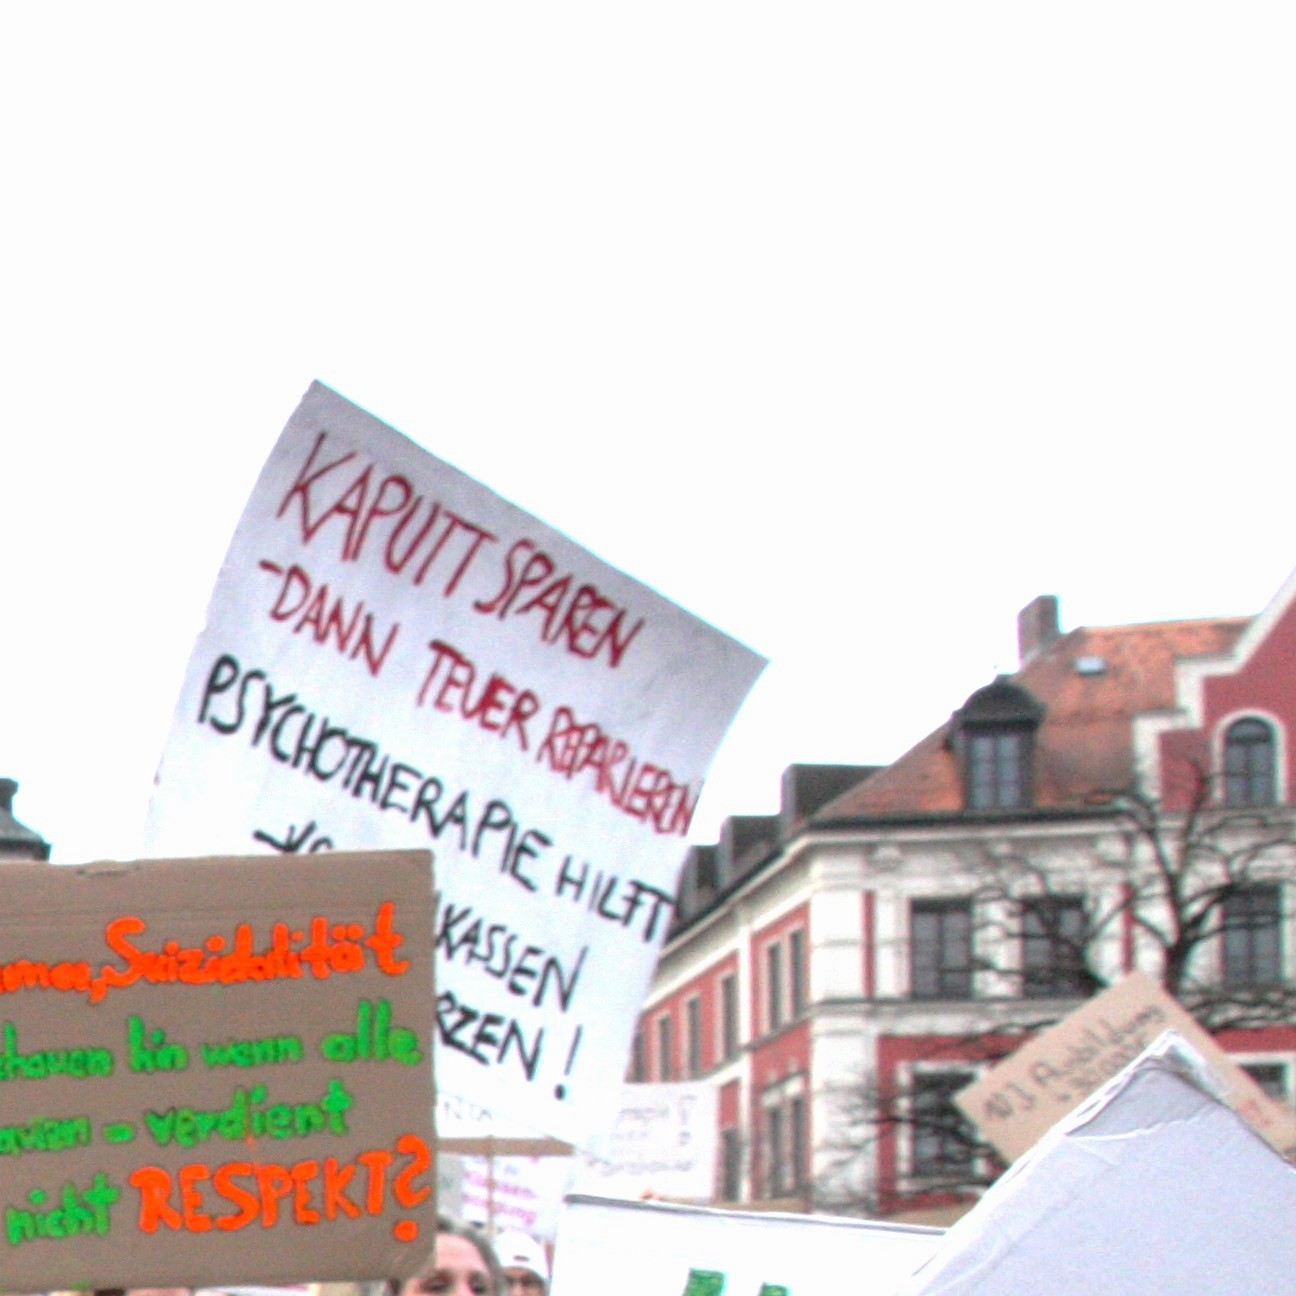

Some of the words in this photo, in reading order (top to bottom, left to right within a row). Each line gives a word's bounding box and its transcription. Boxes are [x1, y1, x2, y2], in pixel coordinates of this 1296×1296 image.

[415, 637, 541, 752] TEUER
[197, 652, 555, 894] PSYCHOTHERAPIE
[555, 853, 679, 943] HILFT
[435, 889, 590, 1014] KASSEN
[125, 1012, 190, 1074] hin
[200, 1033, 305, 1068] wenn
[319, 997, 425, 1067] alle
[143, 1077, 356, 1147] verdient
[5, 1171, 123, 1246] nicht
[128, 1132, 433, 1243] RESPEKT?
